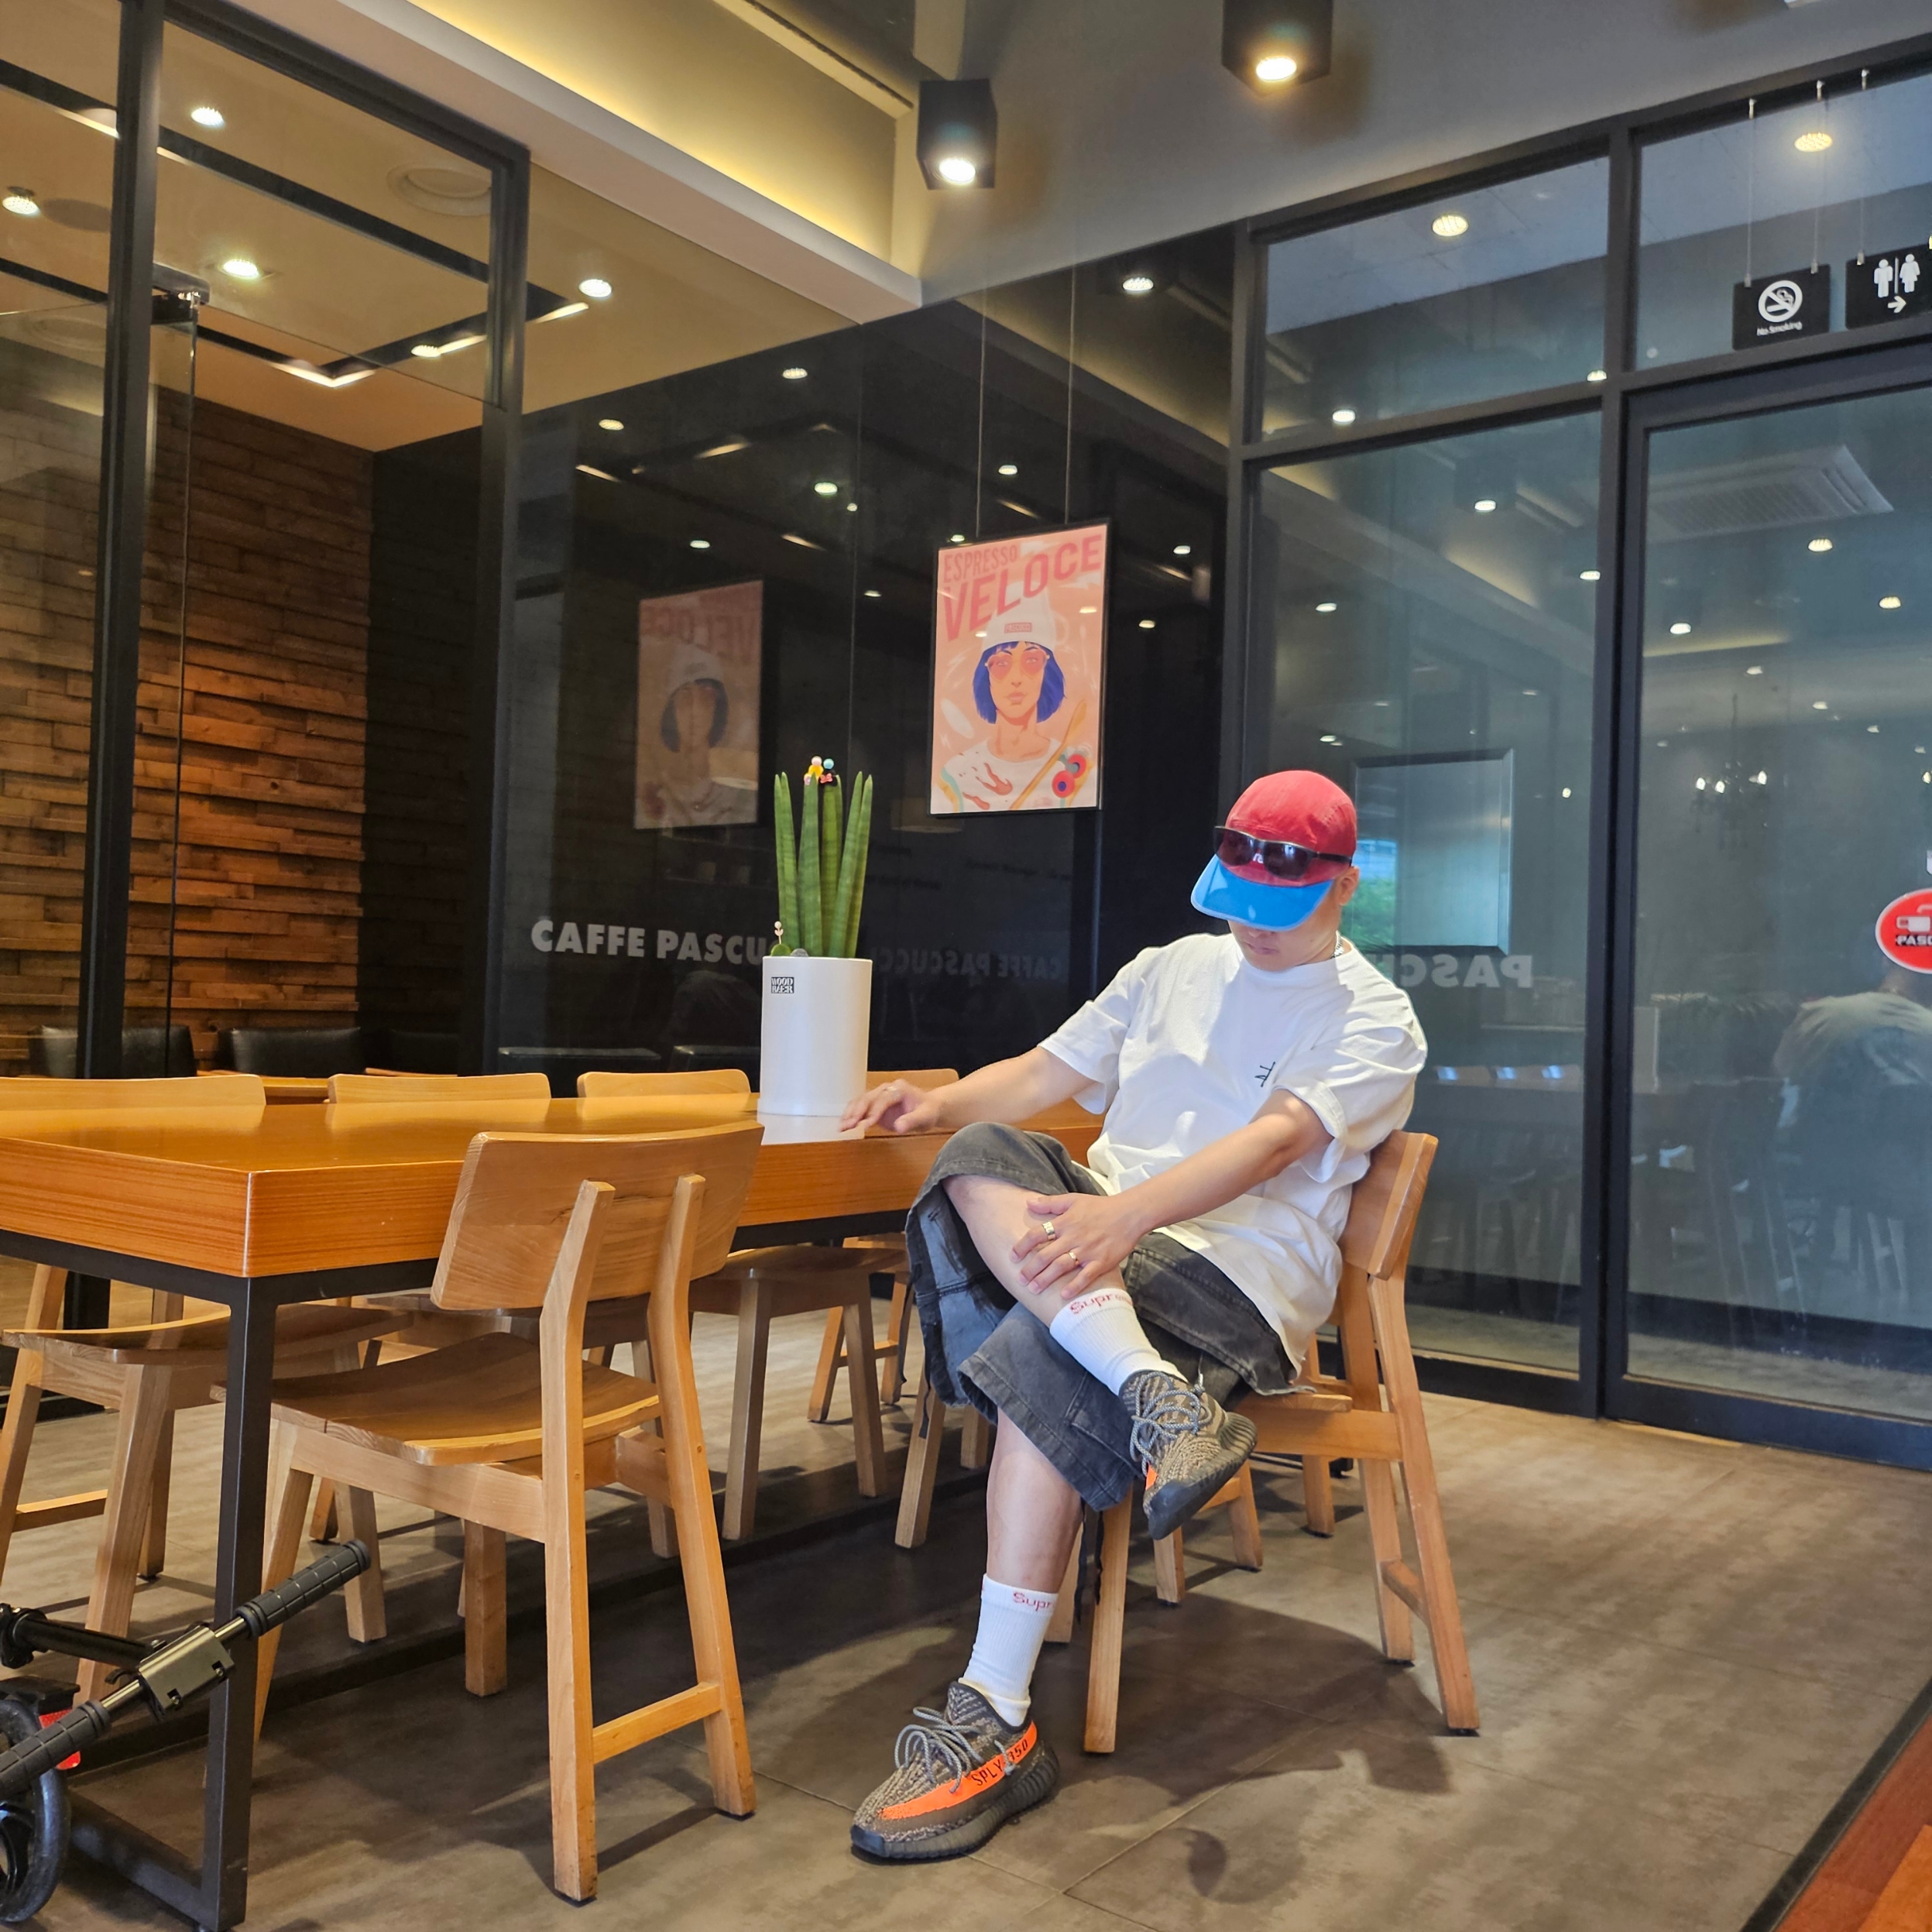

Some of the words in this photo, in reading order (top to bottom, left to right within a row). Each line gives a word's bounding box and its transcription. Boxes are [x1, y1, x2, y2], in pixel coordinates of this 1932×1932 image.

[944, 545, 1017, 583] ESPRESSO
[944, 535, 1102, 642] VELOCE
[531, 919, 645, 957] CAFFE
[657, 930, 776, 965] PASCU
